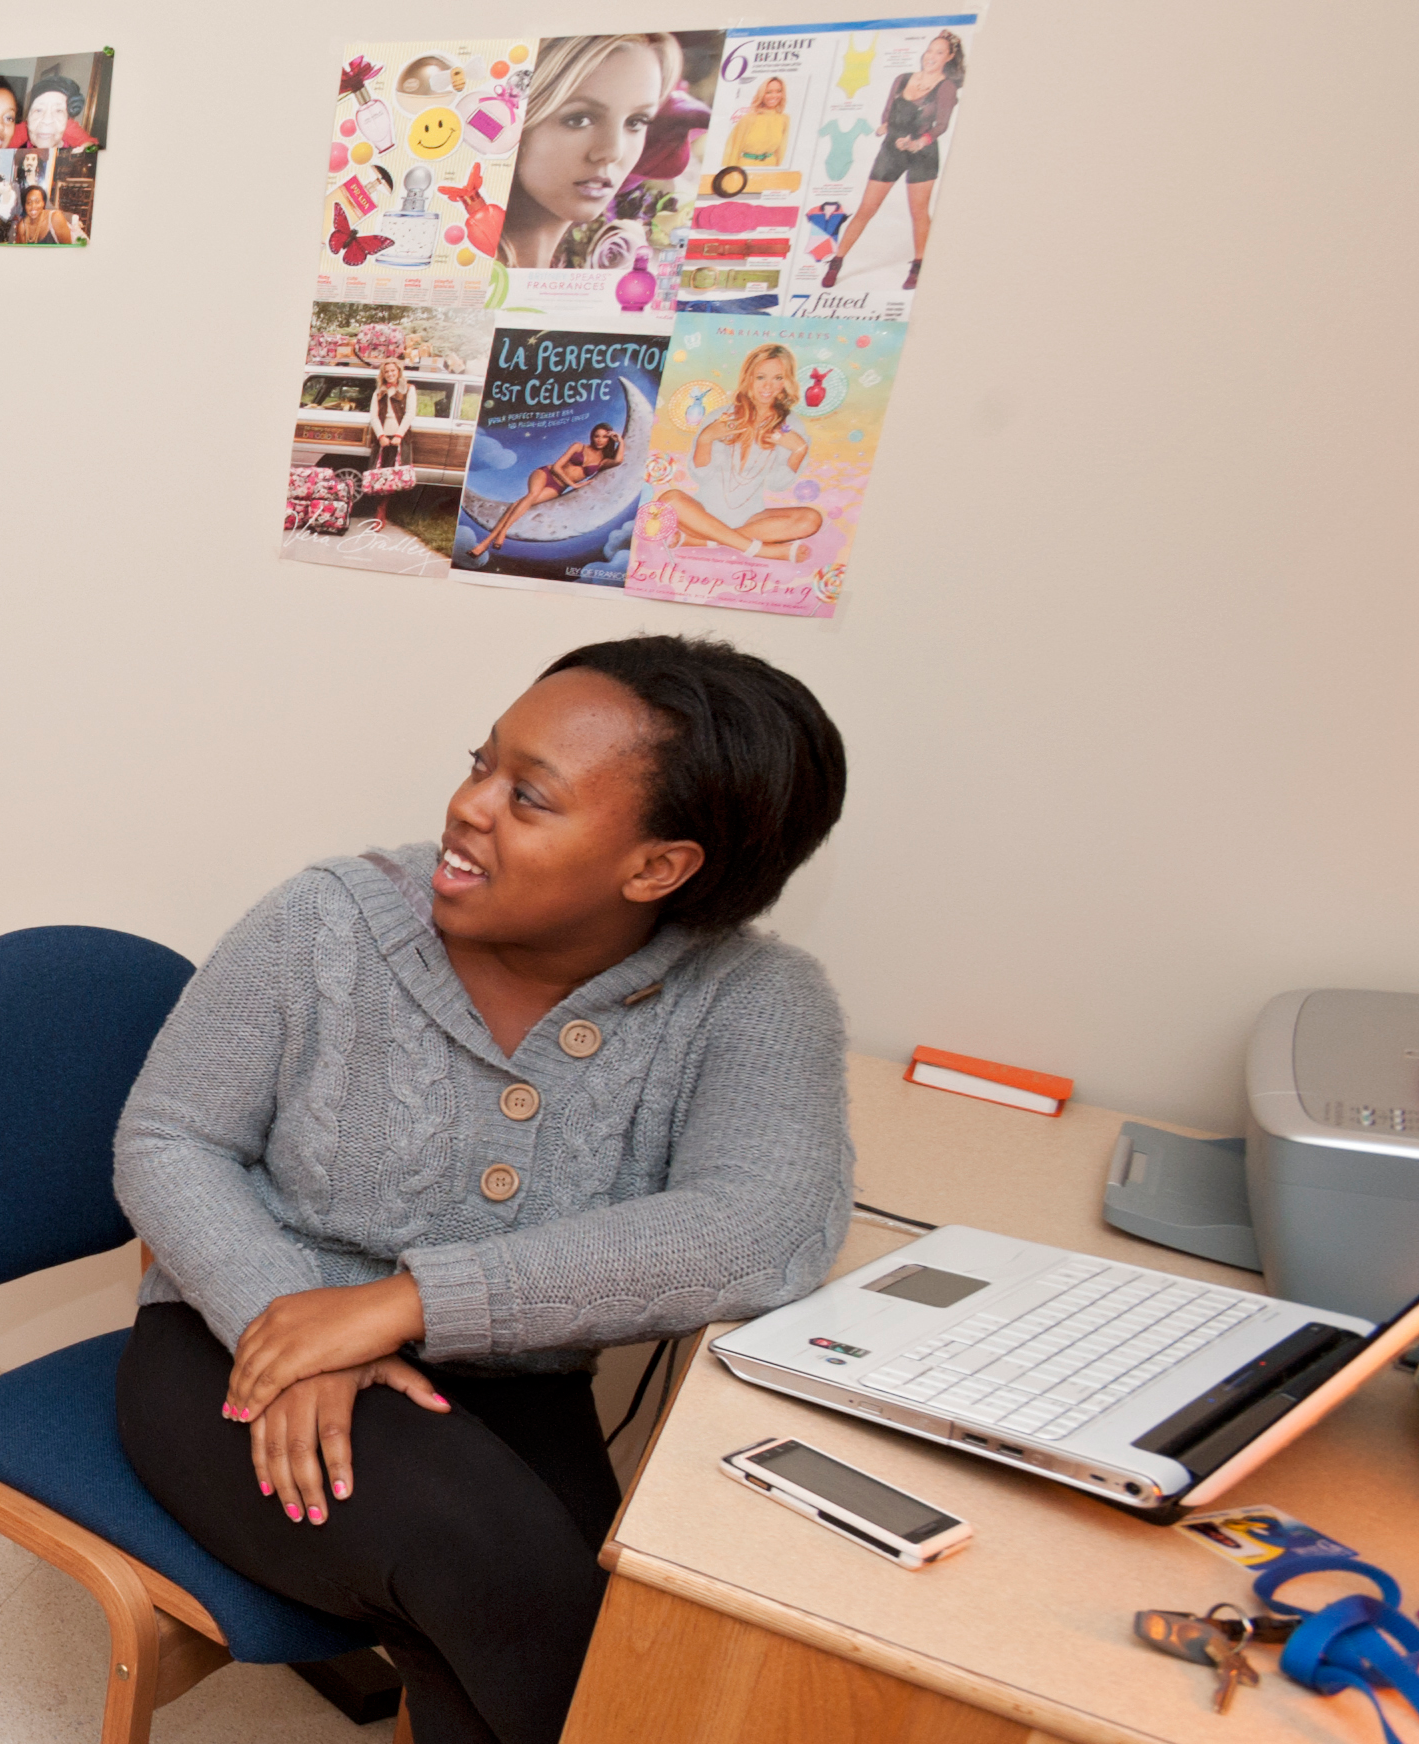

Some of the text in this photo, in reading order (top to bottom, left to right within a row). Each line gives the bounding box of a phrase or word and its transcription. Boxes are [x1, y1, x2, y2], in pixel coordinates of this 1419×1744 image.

[753, 51, 800, 62] BELTS
[756, 38, 817, 51] BRIGHT
[721, 40, 755, 82] 6
[526, 282, 605, 291] FRAGRANCES
[790, 294, 812, 317] 7
[813, 291, 869, 314] fitted
[716, 327, 771, 337] MARIAH
[498, 337, 528, 371] LA
[492, 378, 612, 406] EST CÉLESTE
[283, 505, 451, 576] Vera Bradley
[581, 568, 593, 577] OF
[629, 560, 725, 594] Lollipop
[732, 569, 812, 604] Bling
